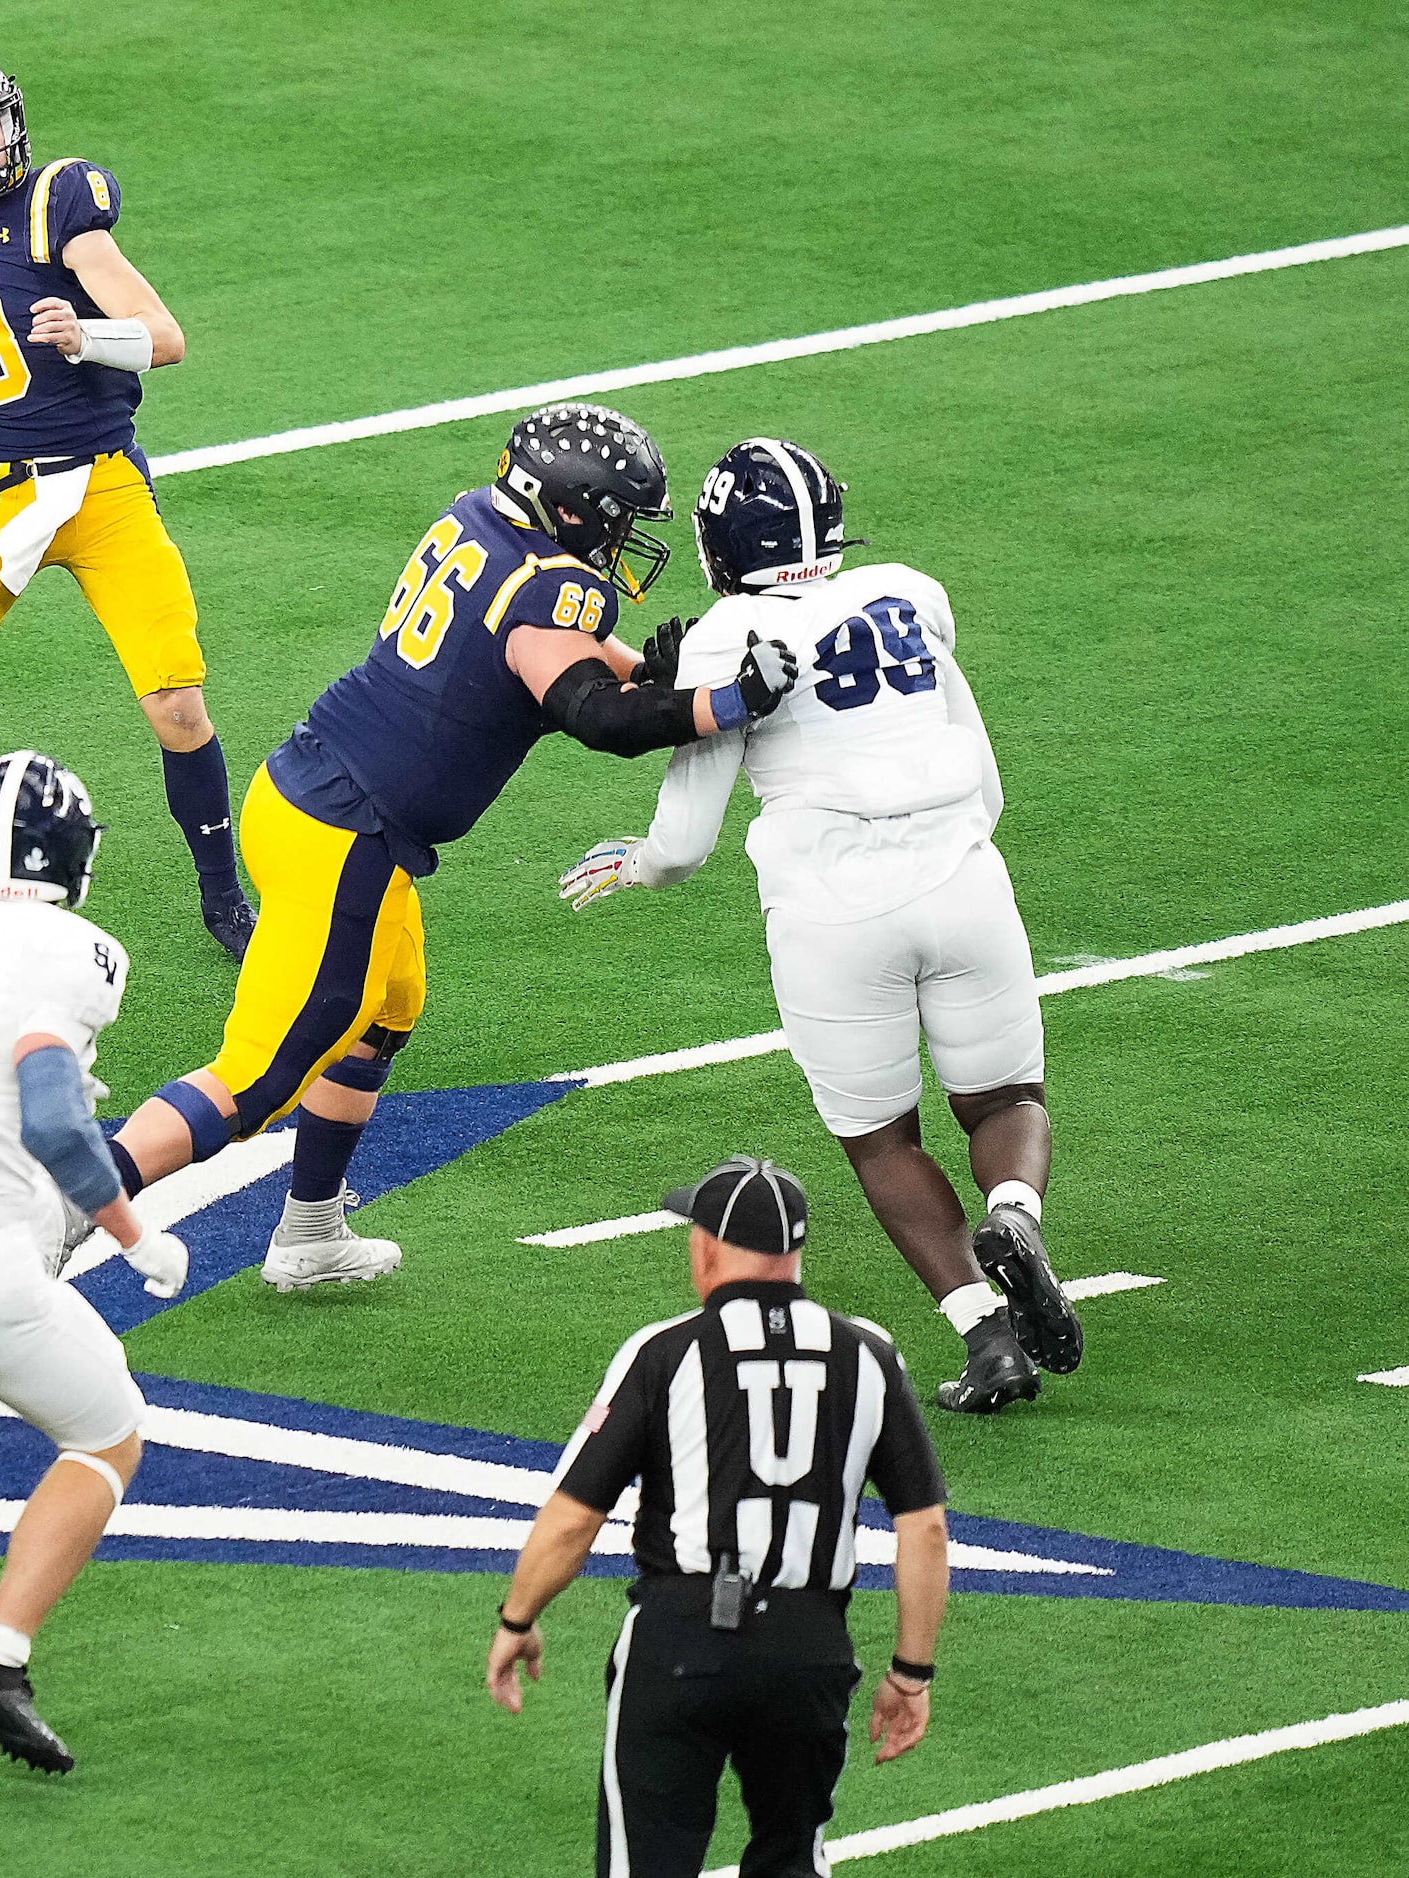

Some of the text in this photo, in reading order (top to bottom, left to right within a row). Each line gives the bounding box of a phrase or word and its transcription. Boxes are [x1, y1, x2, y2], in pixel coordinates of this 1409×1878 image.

[86, 170, 111, 211] 8
[698, 467, 736, 516] 99
[379, 513, 489, 670] 66
[551, 581, 606, 633] 66
[812, 596, 937, 711] 99
[736, 1359, 827, 1487] U
